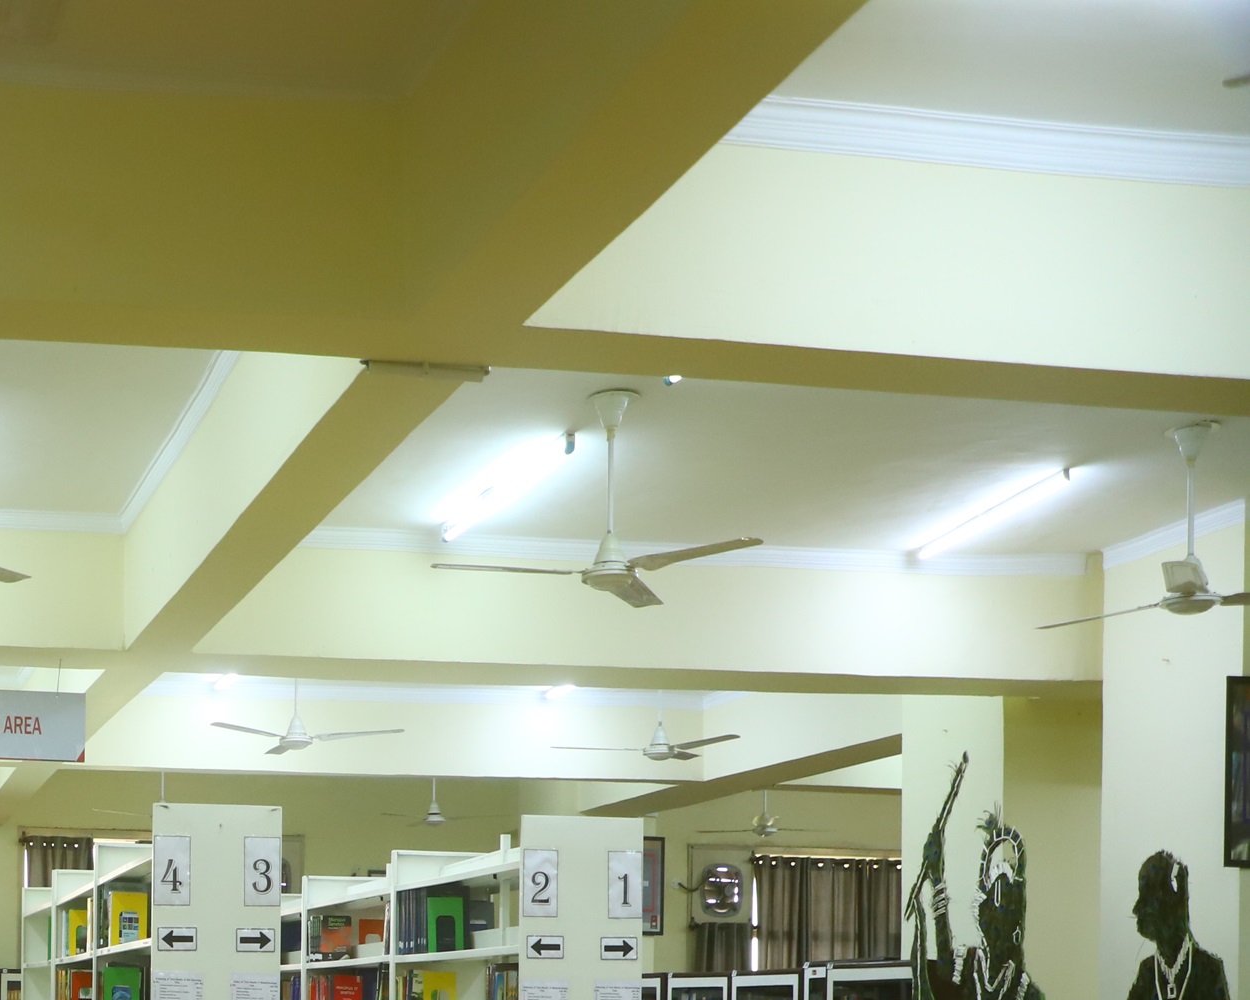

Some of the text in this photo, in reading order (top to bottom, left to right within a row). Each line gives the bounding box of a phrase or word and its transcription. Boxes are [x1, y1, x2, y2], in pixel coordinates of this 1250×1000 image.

[3, 715, 42, 735] AREA
[160, 858, 183, 894] 4
[252, 858, 274, 895] 3
[531, 870, 551, 905] 2
[617, 873, 632, 907] 1
